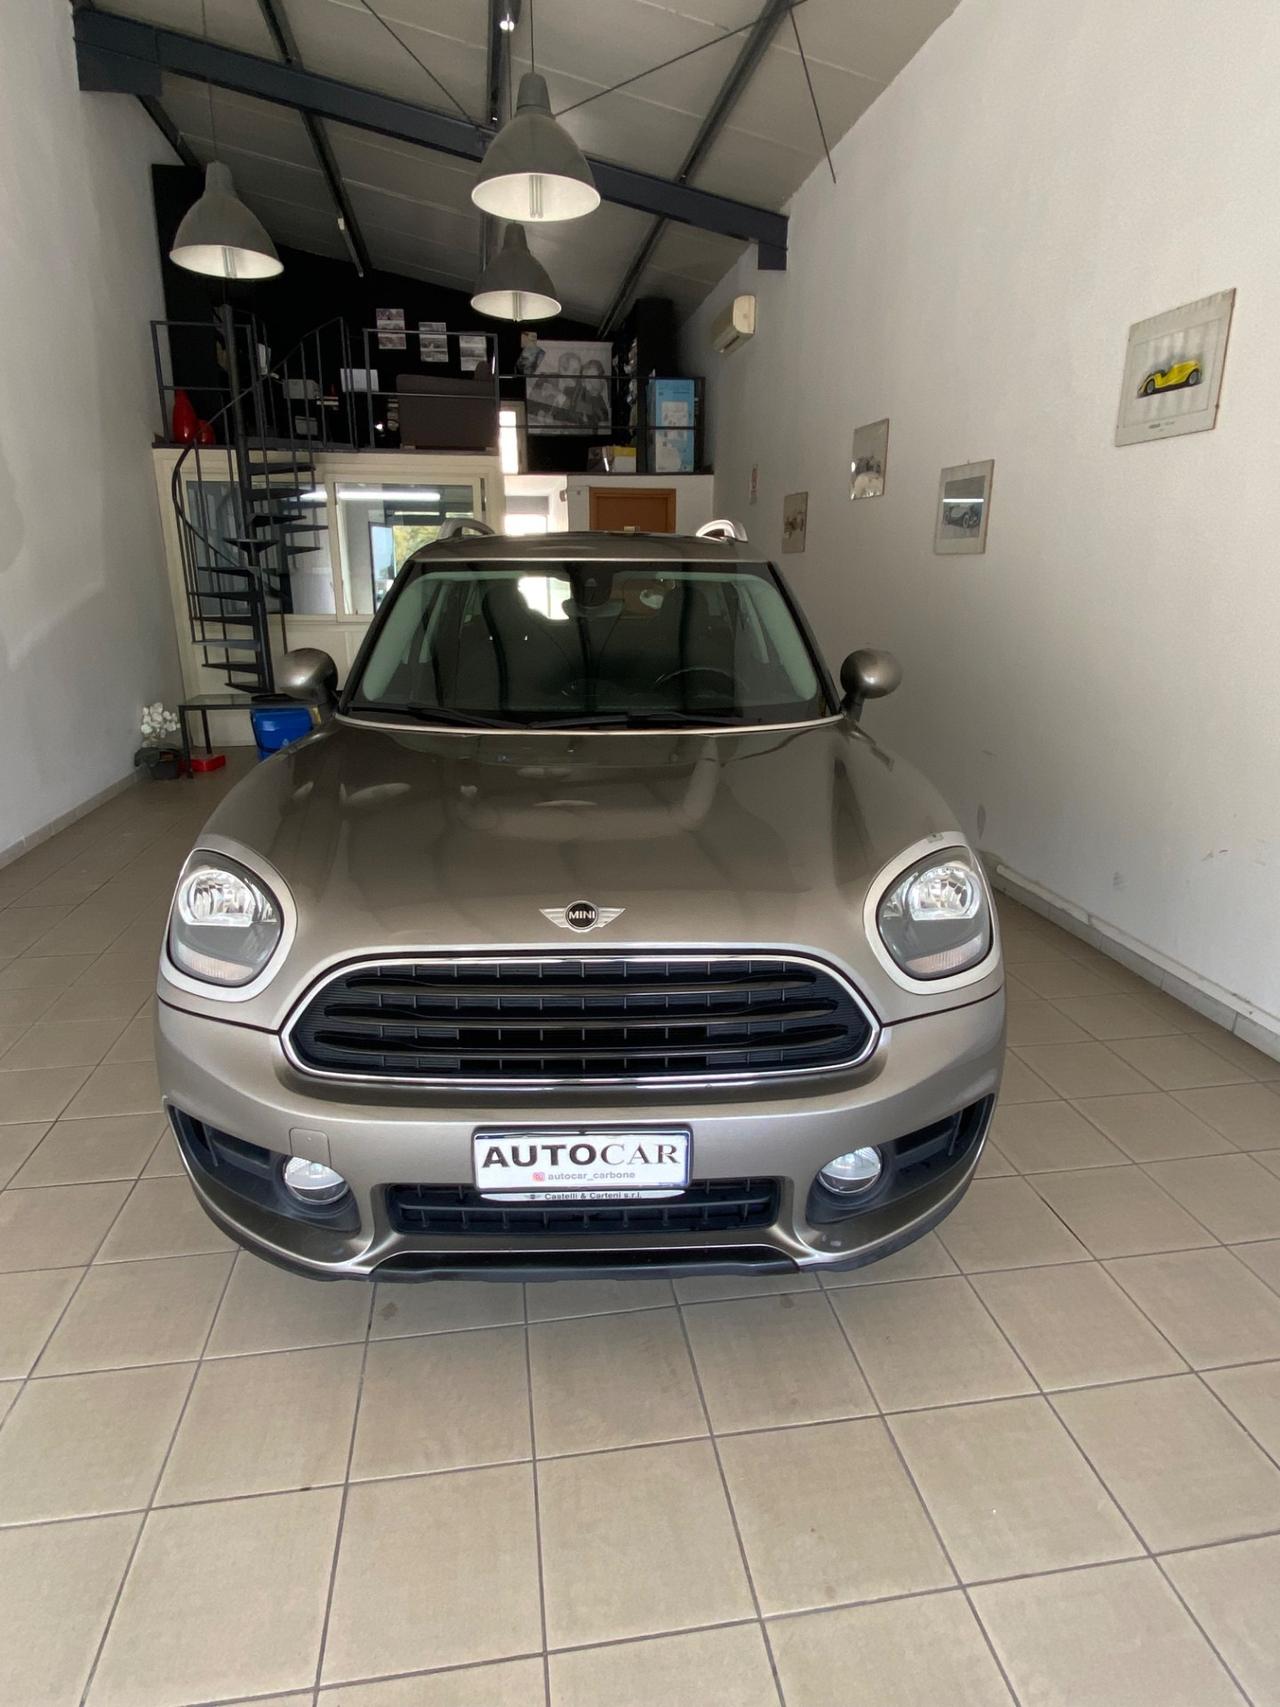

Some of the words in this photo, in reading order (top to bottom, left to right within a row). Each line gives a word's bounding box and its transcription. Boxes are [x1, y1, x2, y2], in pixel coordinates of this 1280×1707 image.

[568, 910, 595, 919] MINI
[482, 1143, 681, 1168] AUTOCAR
[547, 1171, 636, 1182] autocar_carbone
